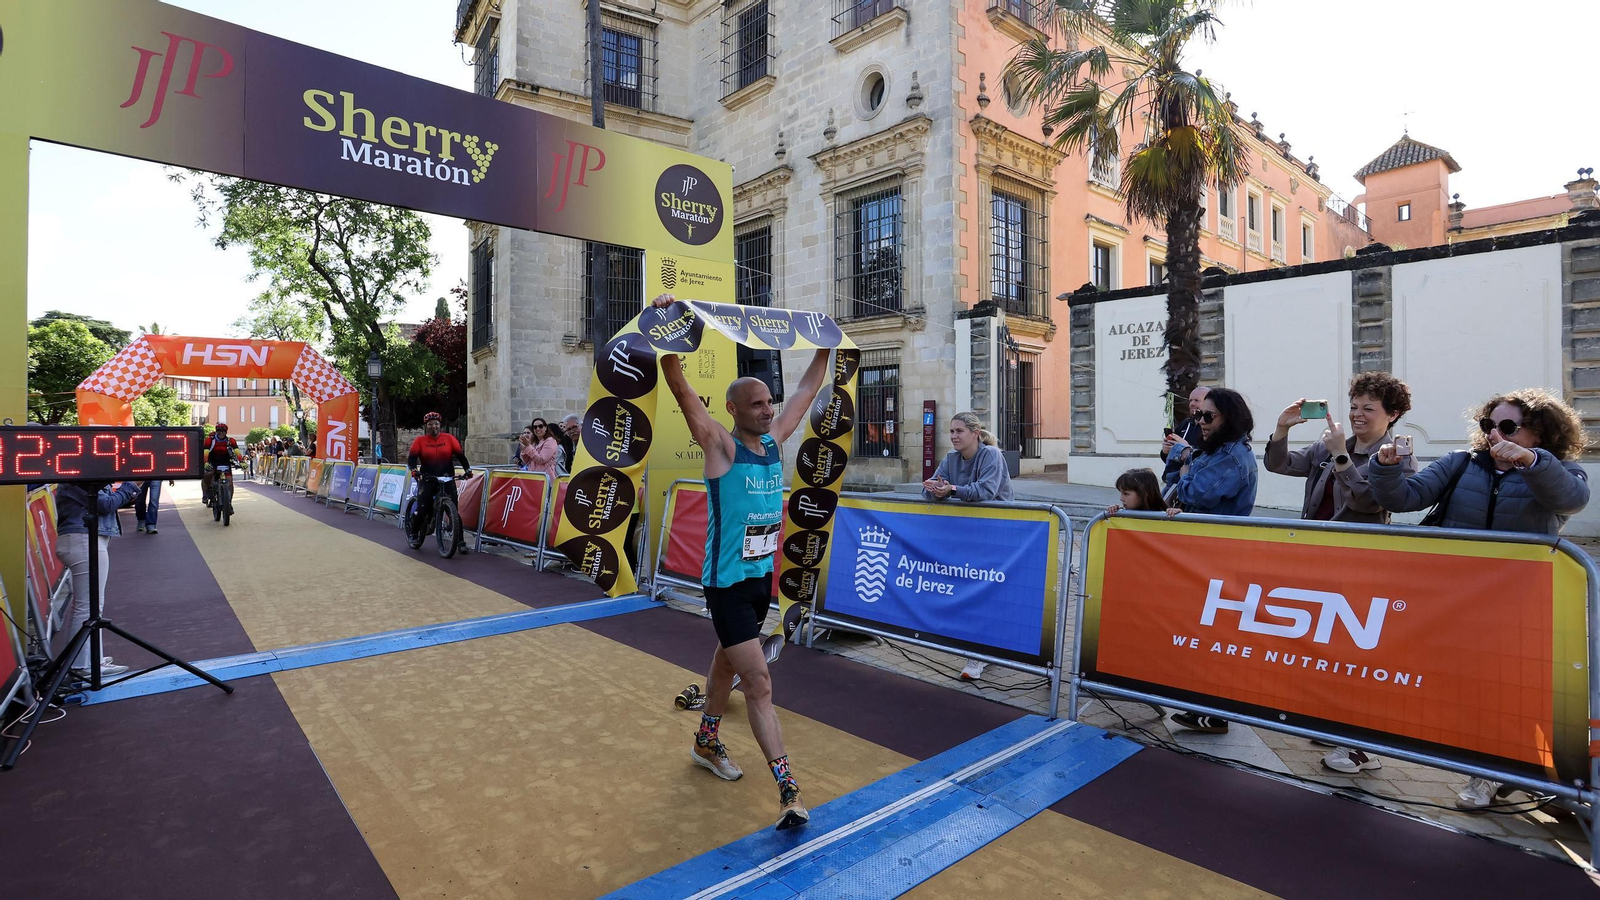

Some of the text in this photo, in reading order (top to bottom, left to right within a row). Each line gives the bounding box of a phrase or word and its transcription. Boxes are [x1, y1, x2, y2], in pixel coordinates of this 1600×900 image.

[303, 89, 499, 184] Sherry
[341, 138, 471, 186] Maratón
[661, 192, 718, 223] Sherry
[671, 209, 710, 225] Maratón
[680, 269, 723, 282] Ayuntamiento
[649, 308, 696, 341] Sherry
[712, 315, 742, 330] erry
[749, 314, 790, 333] Sherry
[1108, 320, 1167, 336] ALCAZA
[1120, 346, 1165, 361] JEREZ
[1132, 334, 1150, 347] DE
[820, 392, 842, 436] Sherry
[606, 403, 631, 462] Sherry
[0, 435, 188, 475] 2:29:53
[675, 451, 706, 460] SCALPE
[812, 443, 831, 485] Sherry
[588, 472, 618, 530] Sherry
[763, 535, 769, 548] 1
[802, 532, 817, 566] Sherry
[580, 541, 603, 576] erry
[589, 550, 603, 581] aratón
[897, 554, 1006, 583] Ayuntamiento
[895, 575, 955, 596] de Jerez
[1172, 634, 1423, 688] WE ARE NUTRITION!
